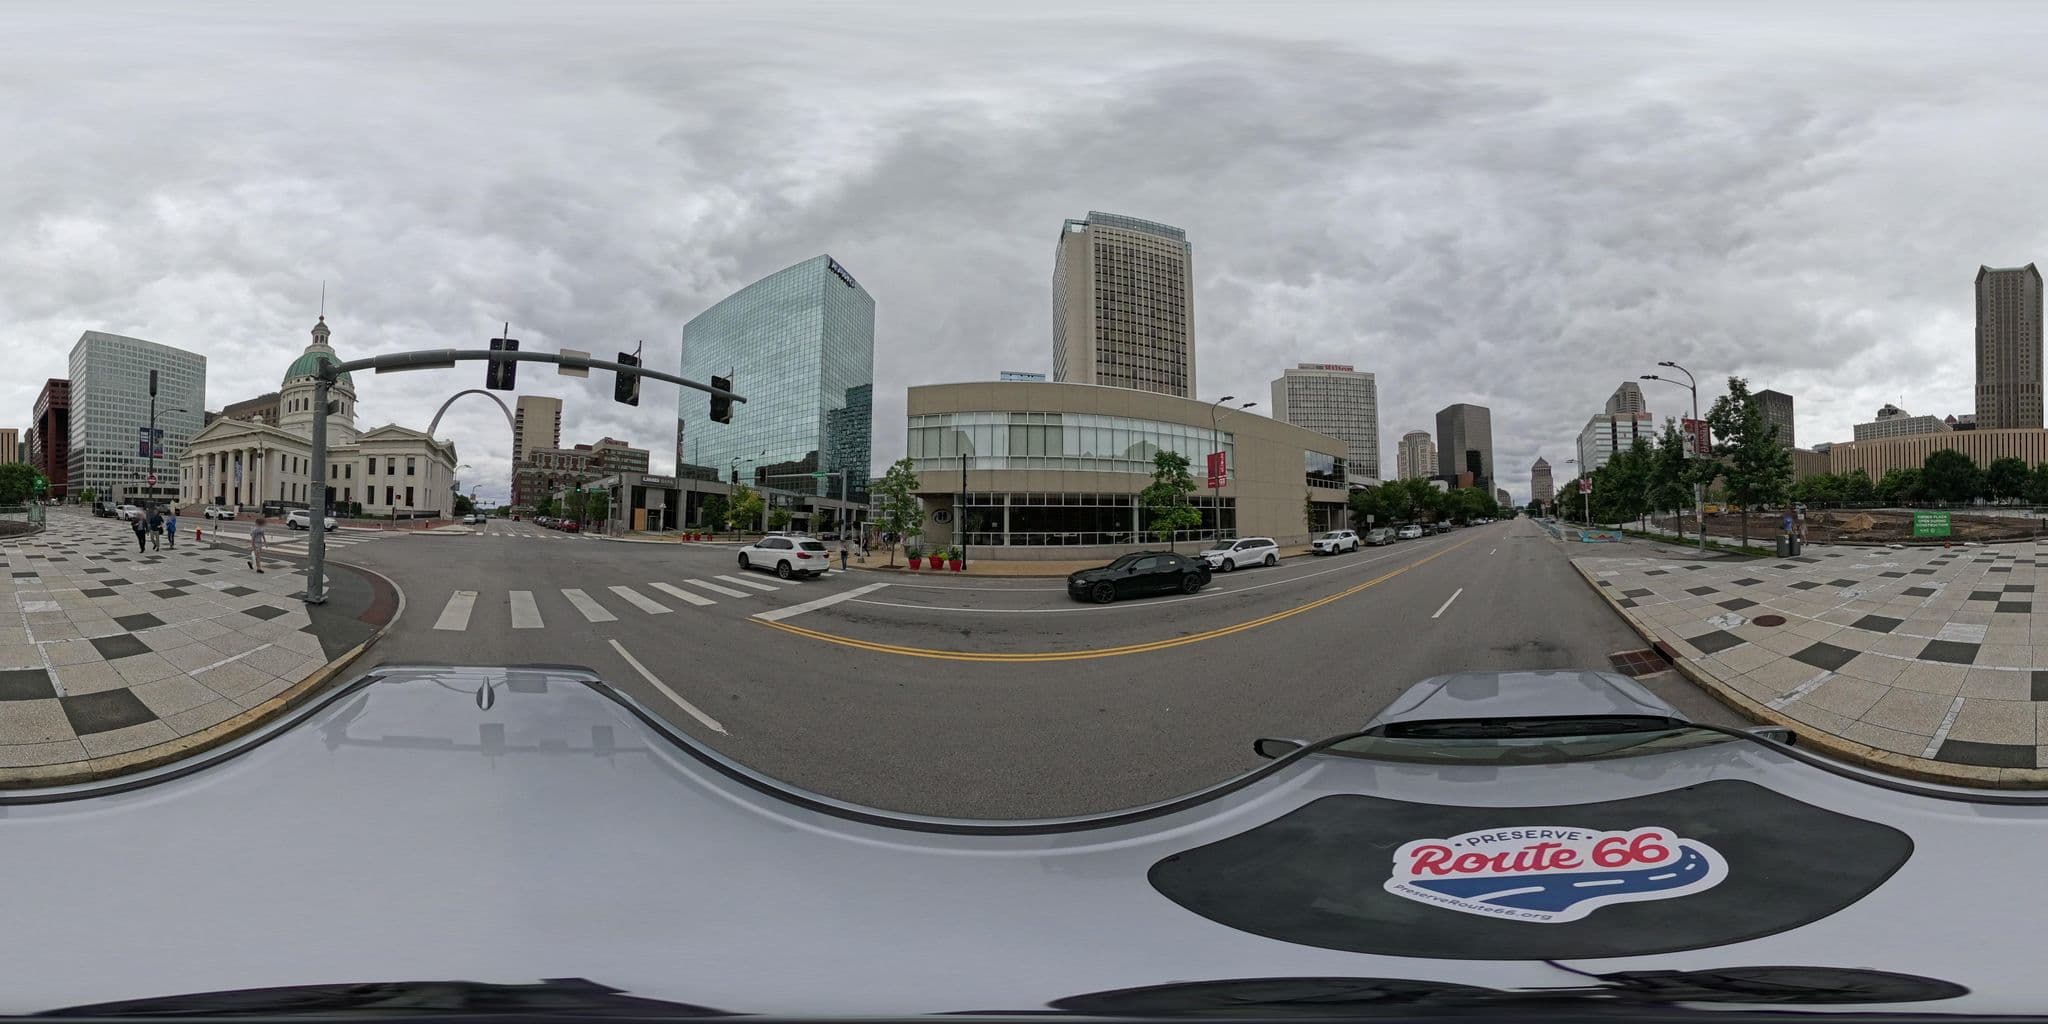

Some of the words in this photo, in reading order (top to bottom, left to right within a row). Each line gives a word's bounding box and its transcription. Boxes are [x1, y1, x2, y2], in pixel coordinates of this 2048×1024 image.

[1324, 364, 1353, 372] Hilton
[1466, 830, 1582, 846] PRESERVE
[1410, 842, 1584, 875] Route
[1592, 833, 1670, 868] 66
[1394, 884, 1552, 920] PreserveRoute66.org
